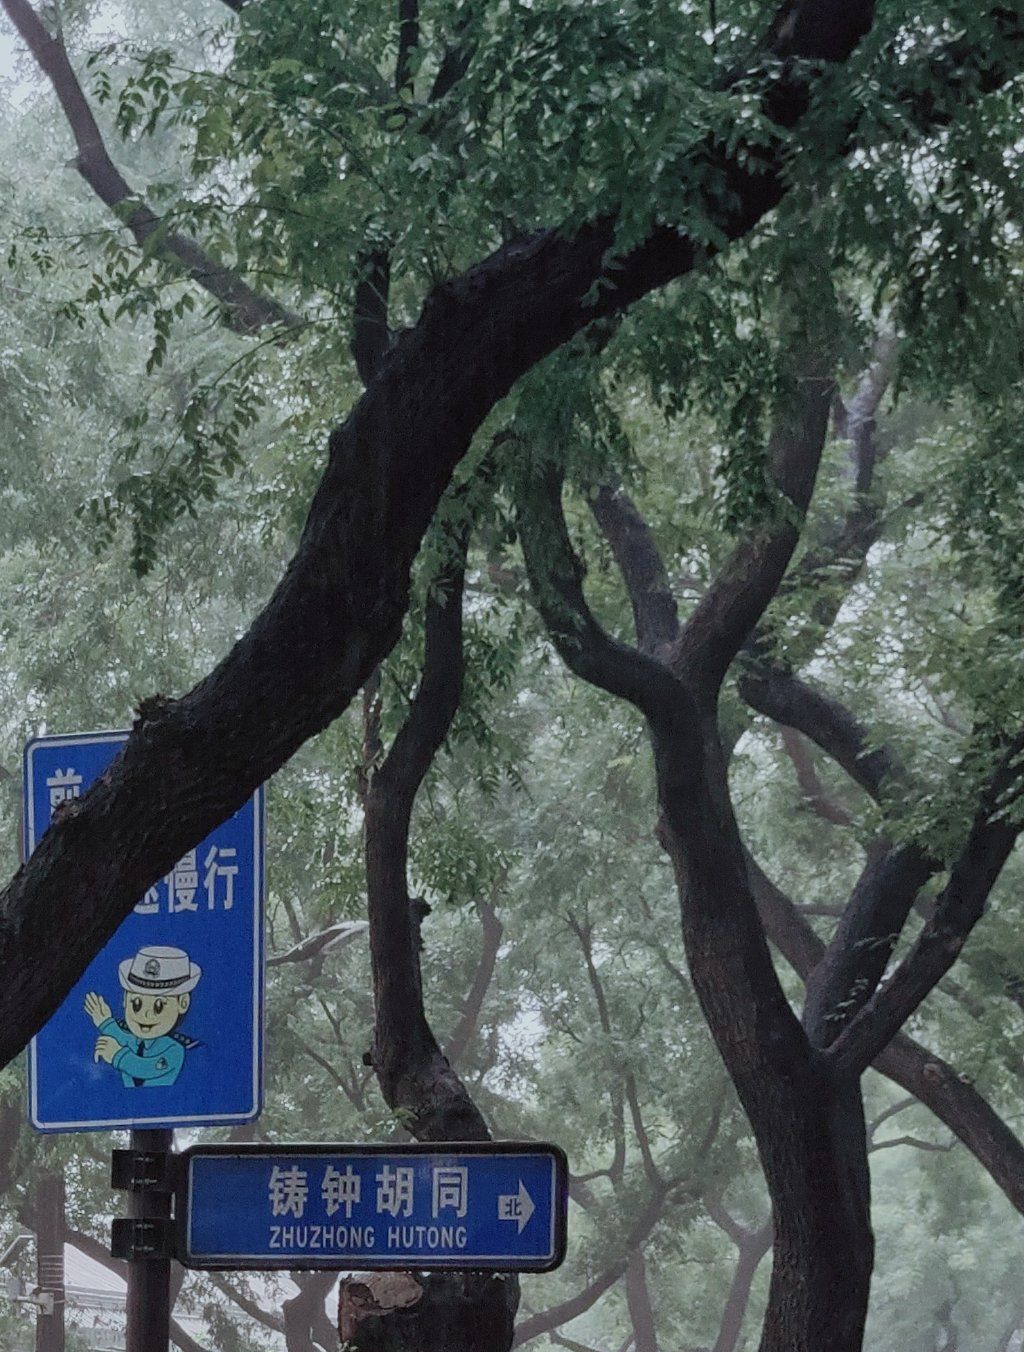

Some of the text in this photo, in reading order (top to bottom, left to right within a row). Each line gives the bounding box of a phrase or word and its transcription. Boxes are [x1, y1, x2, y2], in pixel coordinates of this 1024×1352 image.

[268, 1165, 469, 1219] 铸钟胡同
[505, 1198, 522, 1217] 北
[269, 1226, 468, 1249] ZHUZHONG HUTONG
